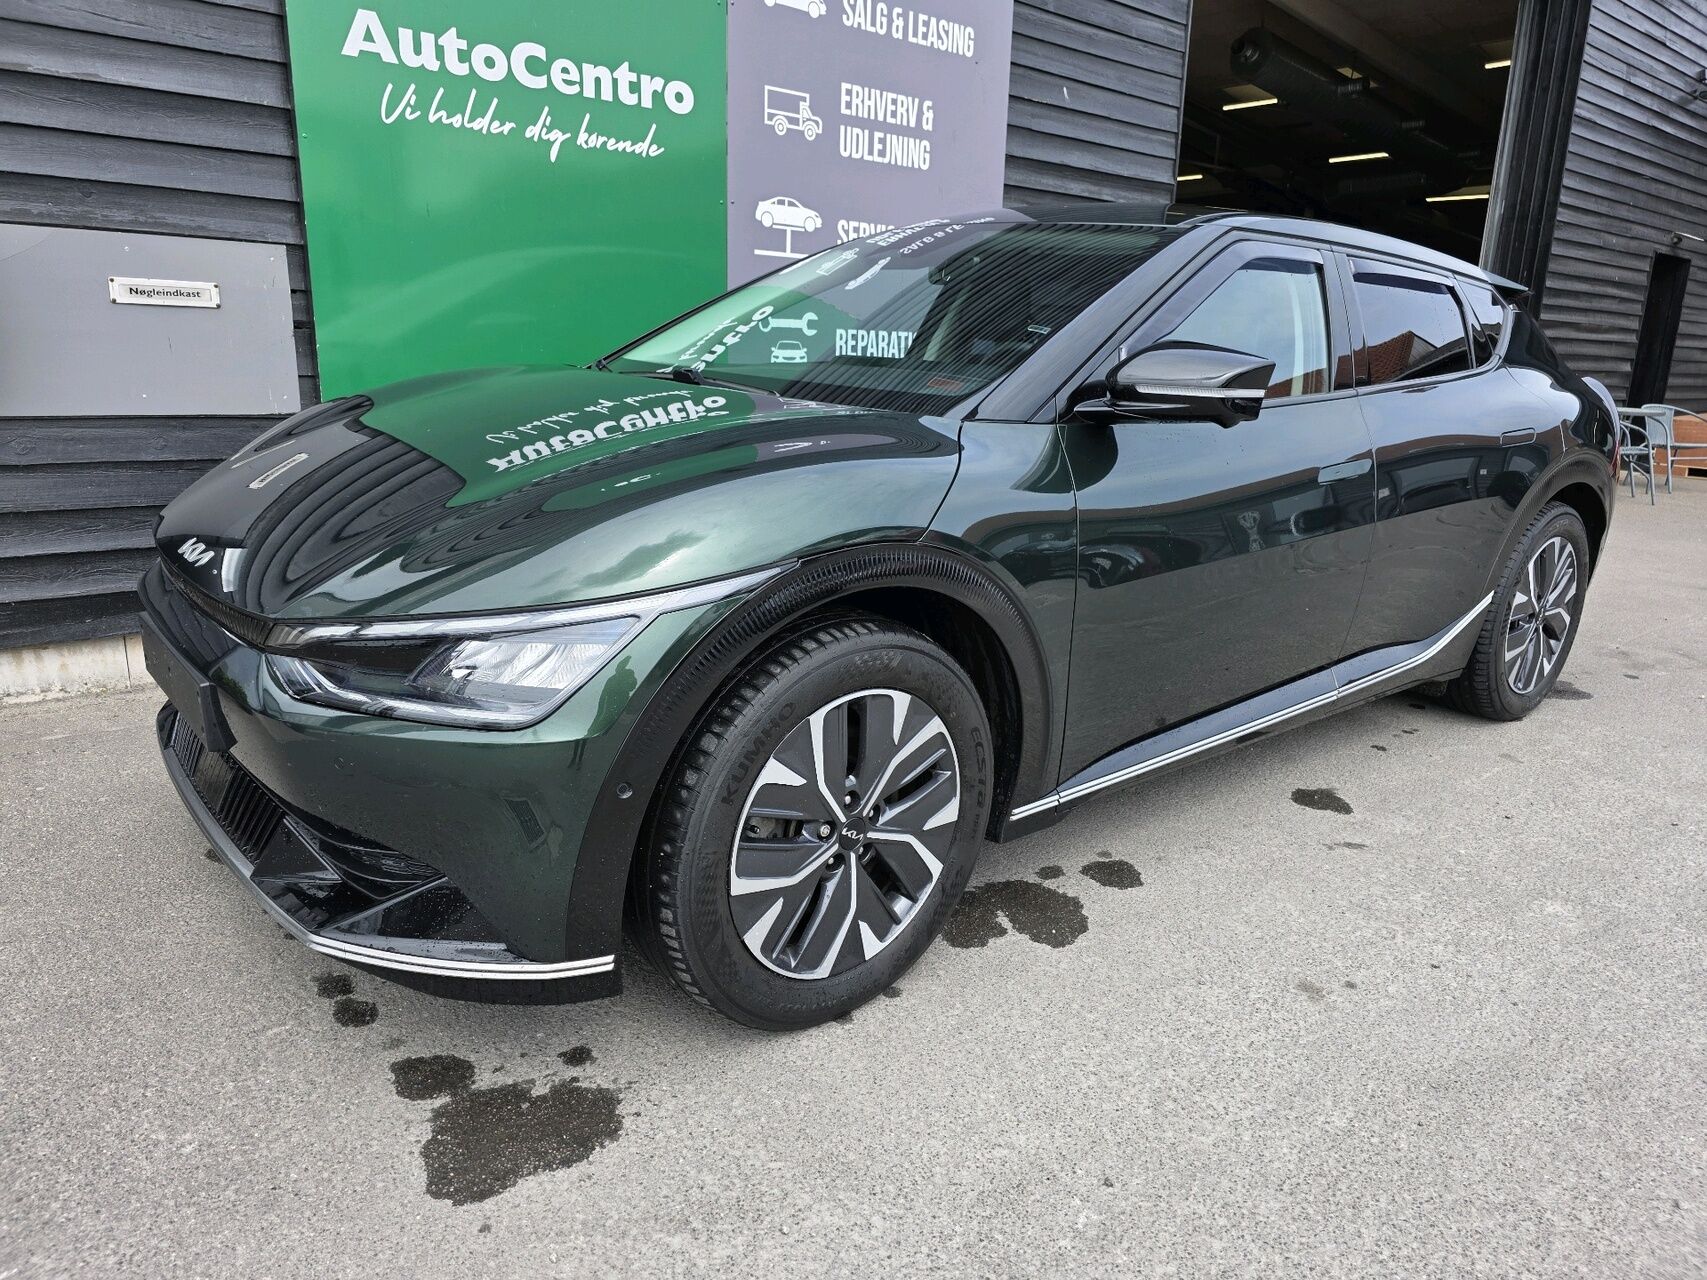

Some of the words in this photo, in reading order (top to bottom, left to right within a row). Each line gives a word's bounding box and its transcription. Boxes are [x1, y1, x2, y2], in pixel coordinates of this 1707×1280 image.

[842, 0, 888, 35] SALG
[891, 6, 904, 40] &
[908, 10, 975, 58] LEASING
[341, 8, 695, 115] AutoCentro
[381, 82, 422, 124] Vi
[428, 86, 517, 135] holder
[525, 106, 571, 163] dig
[840, 82, 919, 128] ERHVERV
[922, 100, 934, 132] &
[839, 125, 931, 170] UDLEJNING
[129, 286, 202, 298] Nøgleindkast
[836, 328, 917, 358] REPARATI
